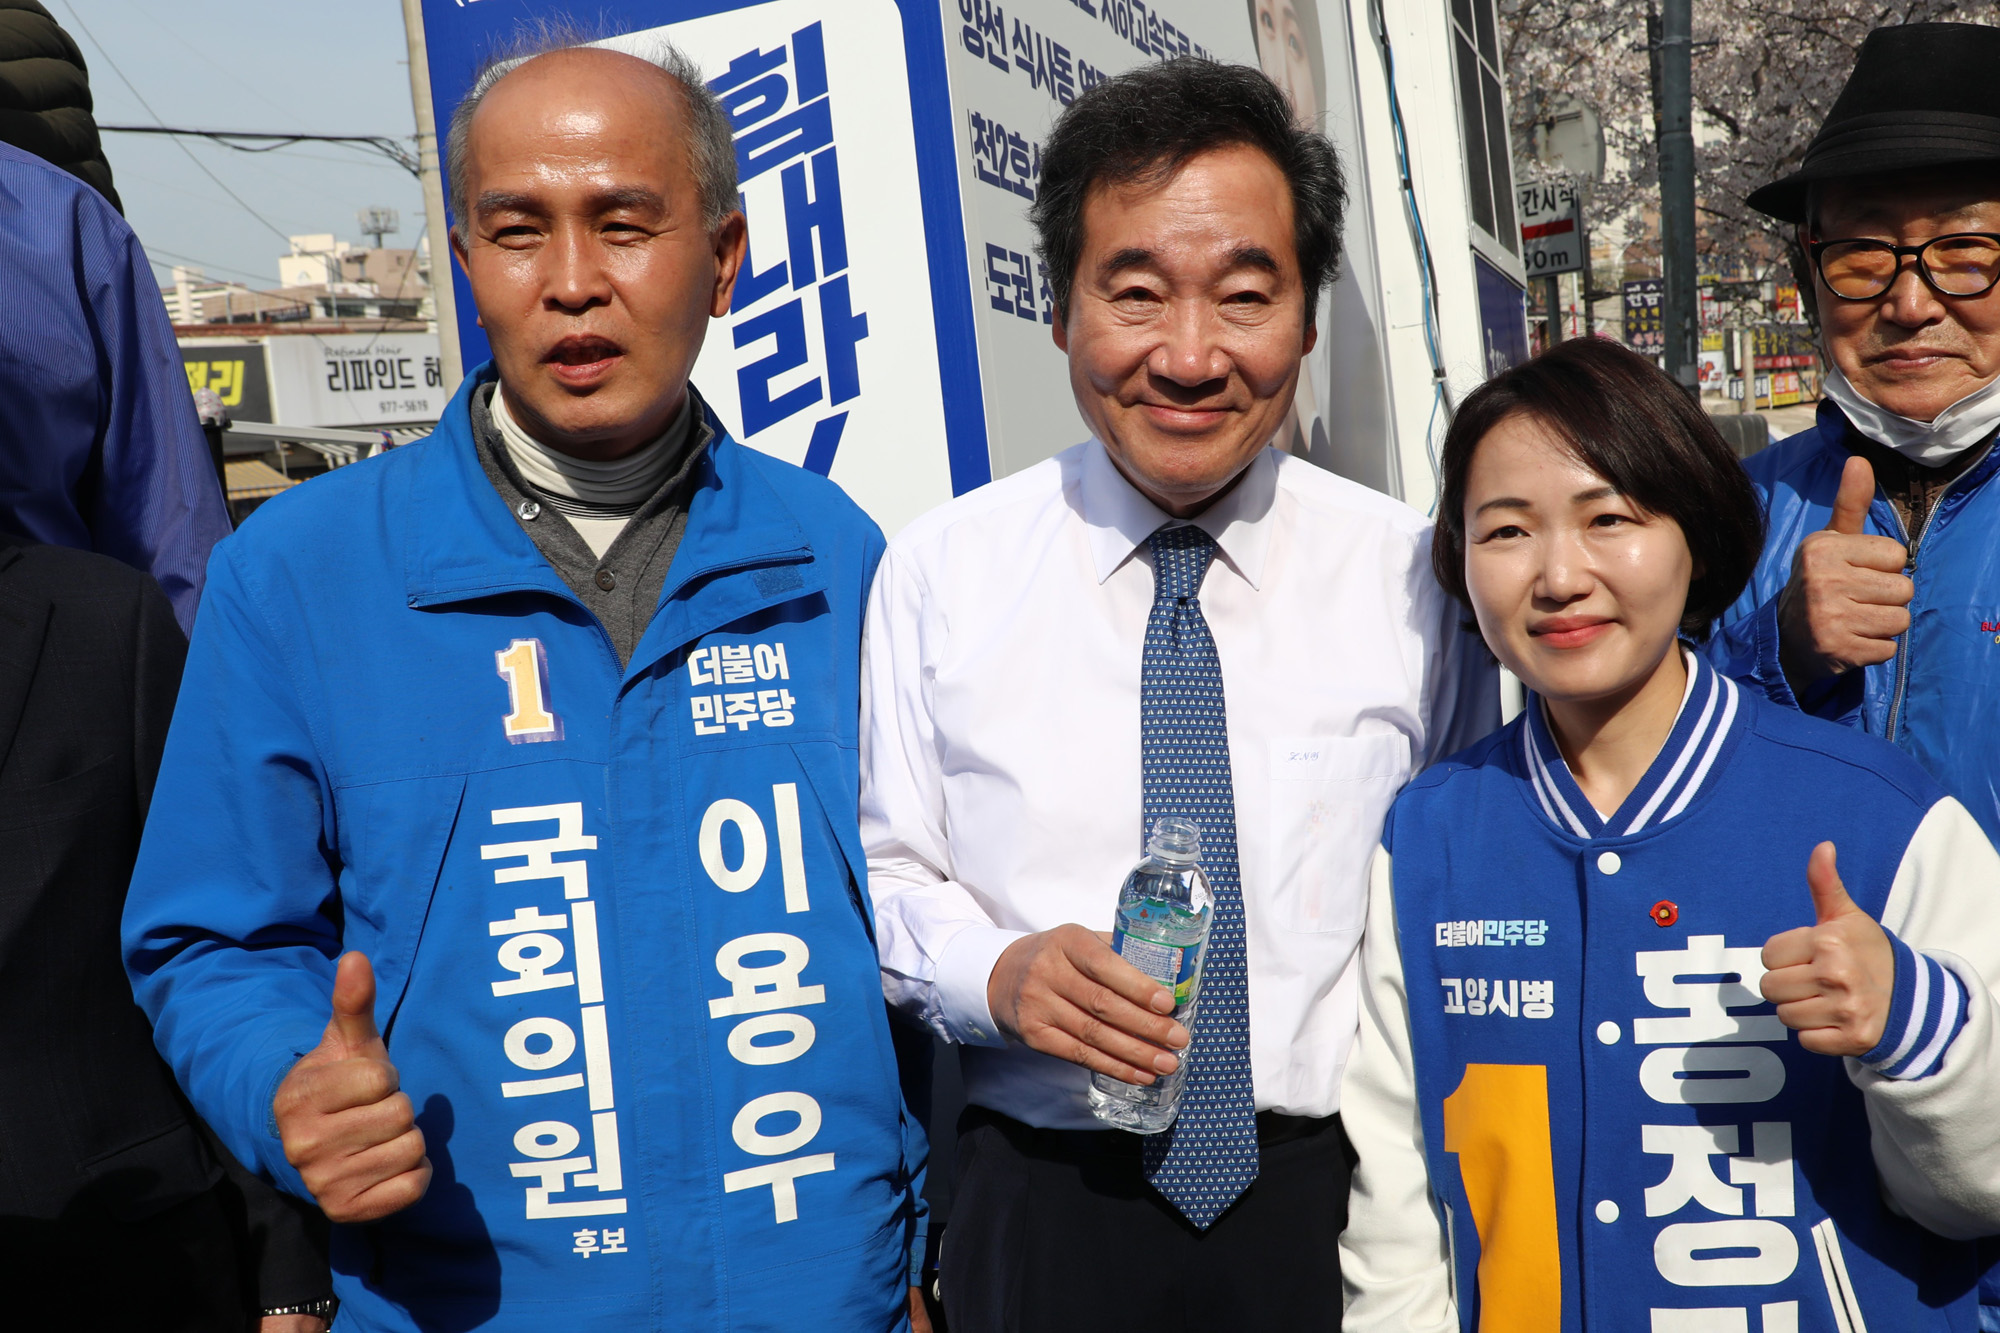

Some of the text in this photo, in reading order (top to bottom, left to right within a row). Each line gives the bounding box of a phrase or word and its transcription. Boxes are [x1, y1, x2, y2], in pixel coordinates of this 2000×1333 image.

[959, 0, 1010, 74] 양선
[1012, 17, 1076, 107] 식사동
[967, 108, 1040, 201] 천2호
[706, 20, 869, 439] 힘내라
[1517, 182, 1575, 217] 간시작
[984, 242, 1037, 322] 도권
[326, 358, 416, 392] 리파인드
[496, 639, 560, 741] 1
[687, 642, 790, 686] 더불어
[690, 688, 796, 736] 민주당
[1435, 919, 1549, 948] 더불어민주당
[480, 801, 628, 1220] 국회의원
[699, 782, 835, 1224] 이용우
[1441, 977, 1554, 1019] 고양시병
[1633, 934, 1800, 1333] 홍정
[1443, 1062, 1562, 1333] 1
[572, 1227, 628, 1259] 후보
